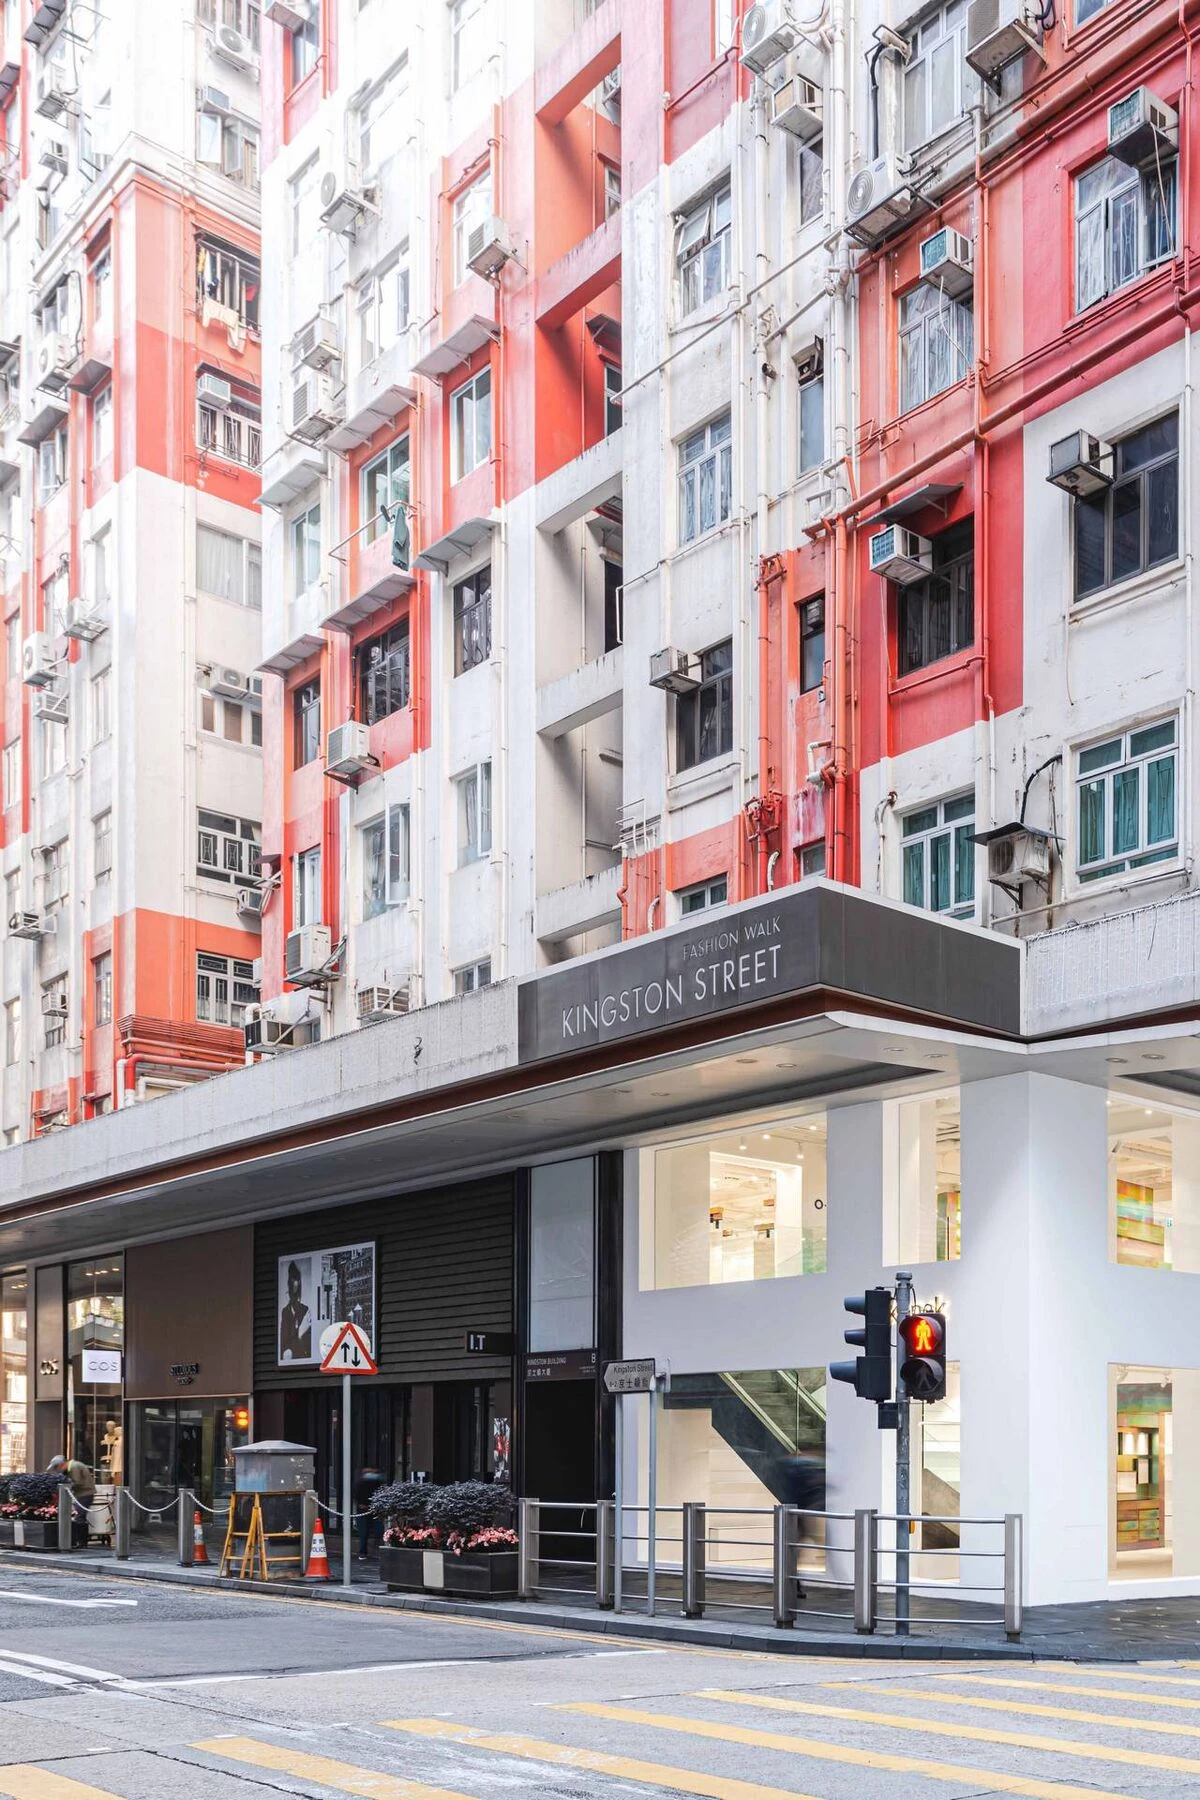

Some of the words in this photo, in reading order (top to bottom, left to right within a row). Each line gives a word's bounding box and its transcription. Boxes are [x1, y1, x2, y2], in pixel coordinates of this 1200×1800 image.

[683, 931, 739, 961] FASHION
[744, 916, 781, 940] WALK
[562, 974, 682, 1038] KINGSTON
[694, 945, 781, 1001] STREET
[470, 1334, 486, 1350] I.T
[527, 1358, 547, 1366] KINGSTON
[591, 1352, 597, 1364] B
[88, 1360, 119, 1372] COS
[613, 1364, 636, 1374] Kingston
